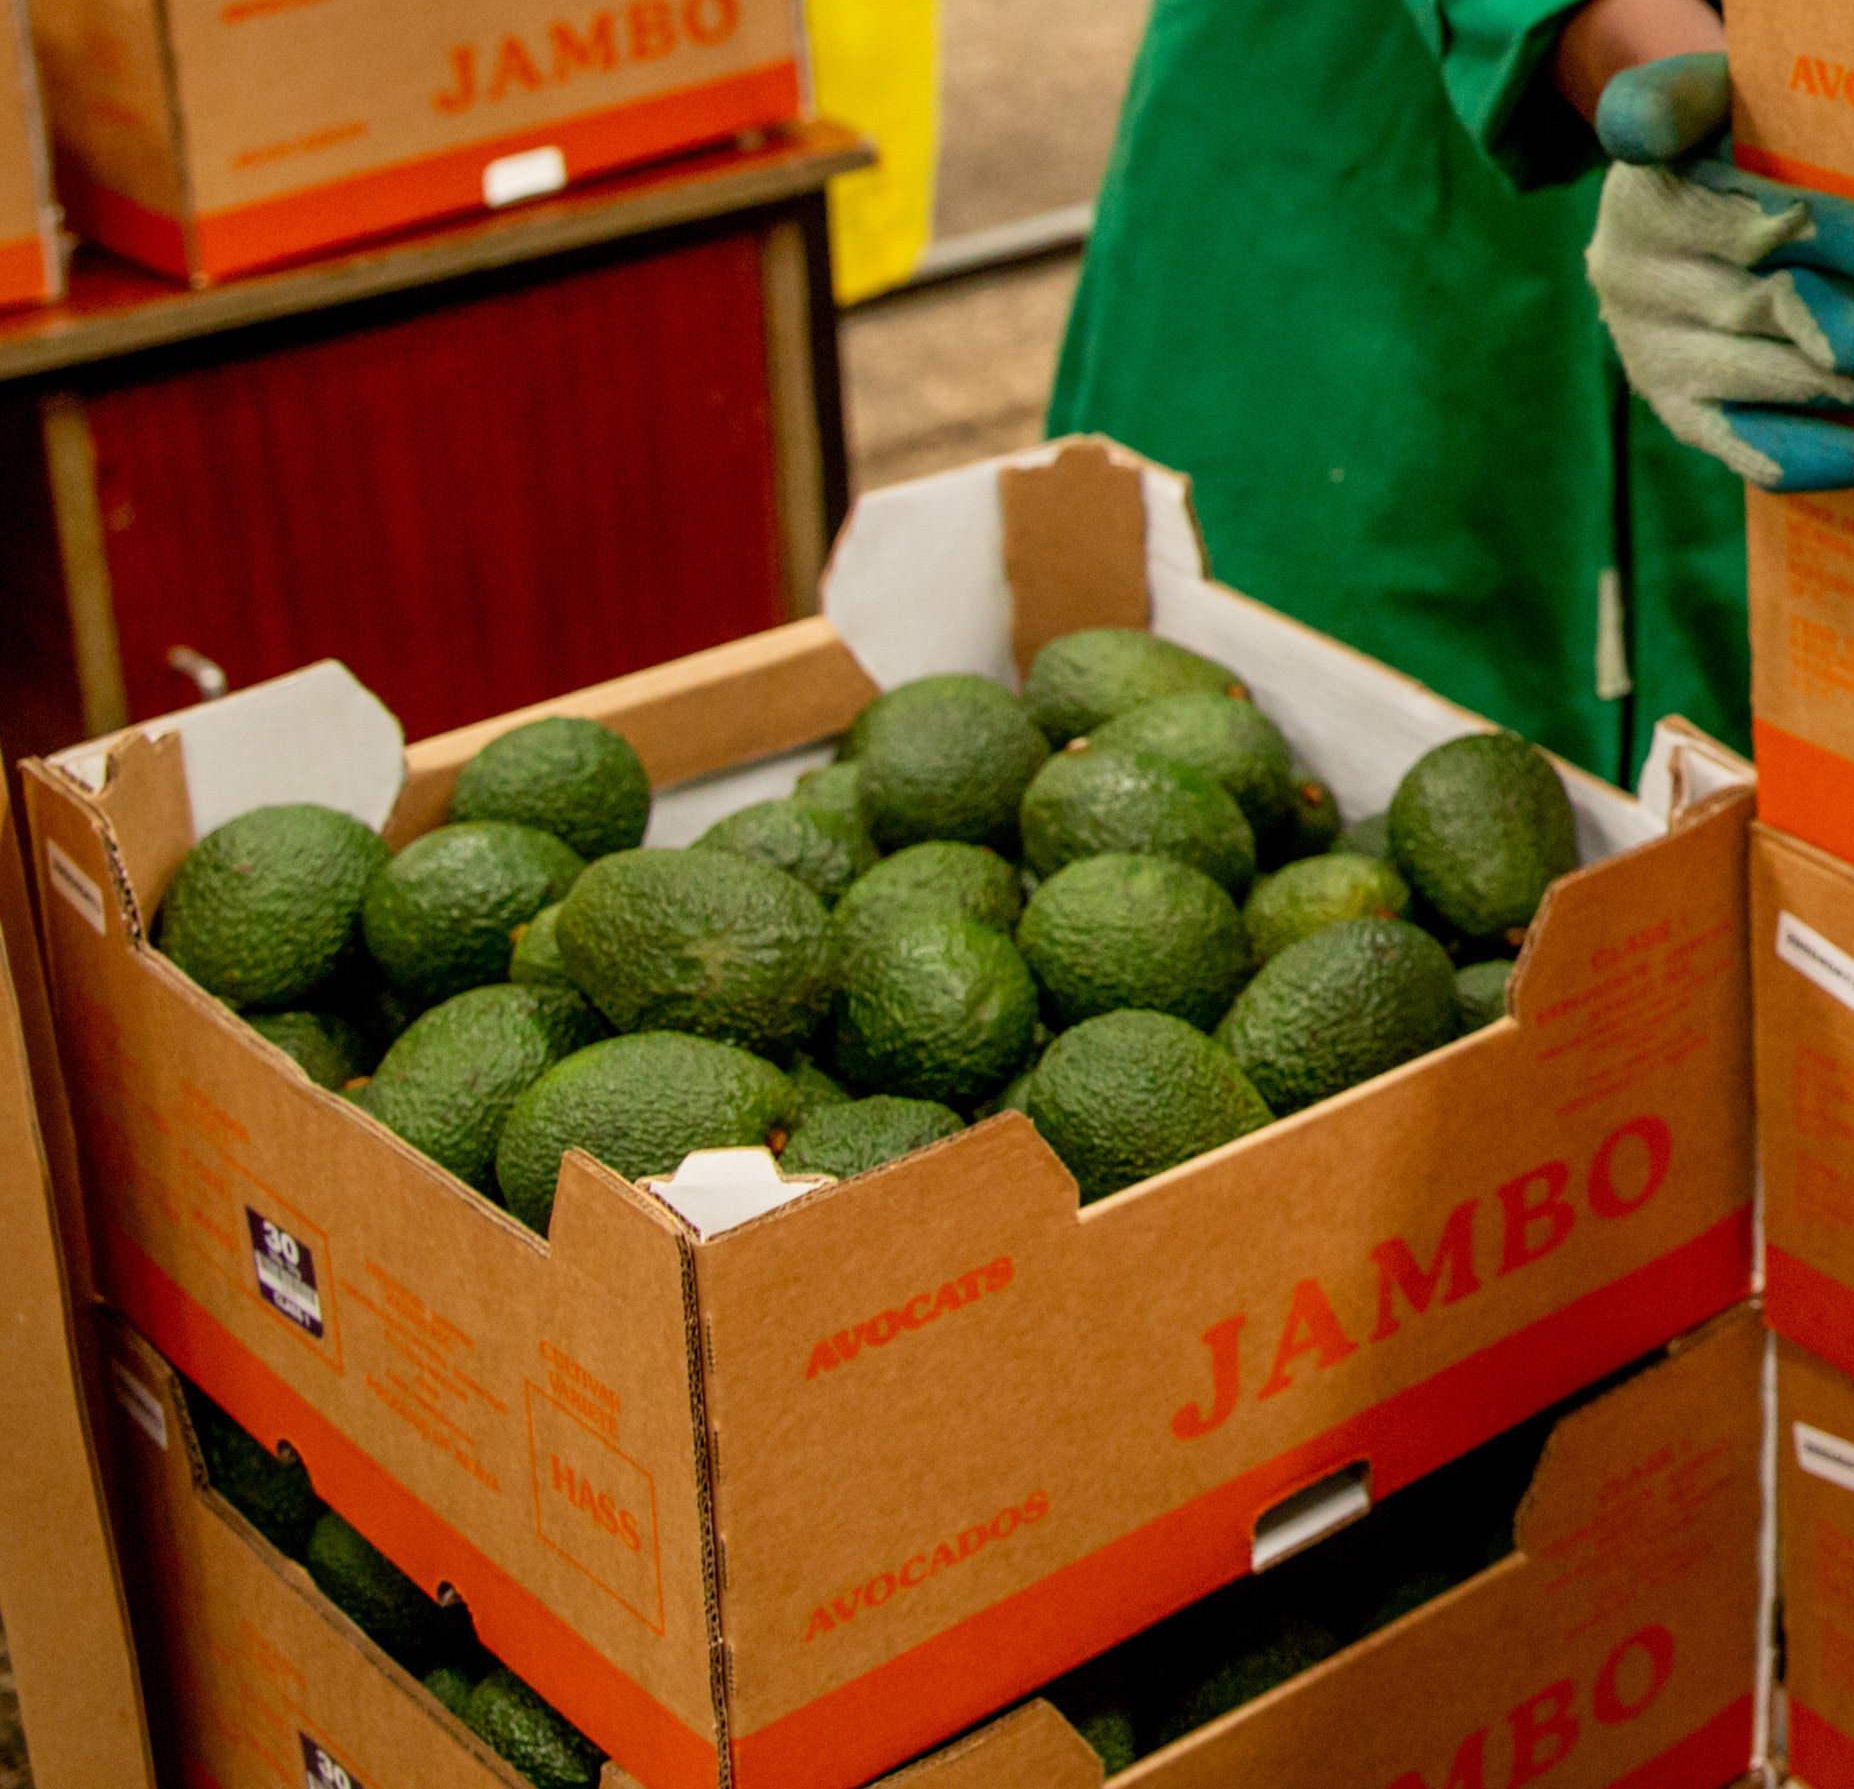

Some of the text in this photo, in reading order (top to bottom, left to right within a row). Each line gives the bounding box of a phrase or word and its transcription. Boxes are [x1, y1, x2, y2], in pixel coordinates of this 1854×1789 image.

[262, 1218, 300, 1267] 30
[1170, 1114, 1673, 1443] JAMBO
[806, 1256, 1016, 1381] AVOCATS
[551, 1453, 642, 1553] HASS
[805, 1489, 1051, 1644] AVOCADOS
